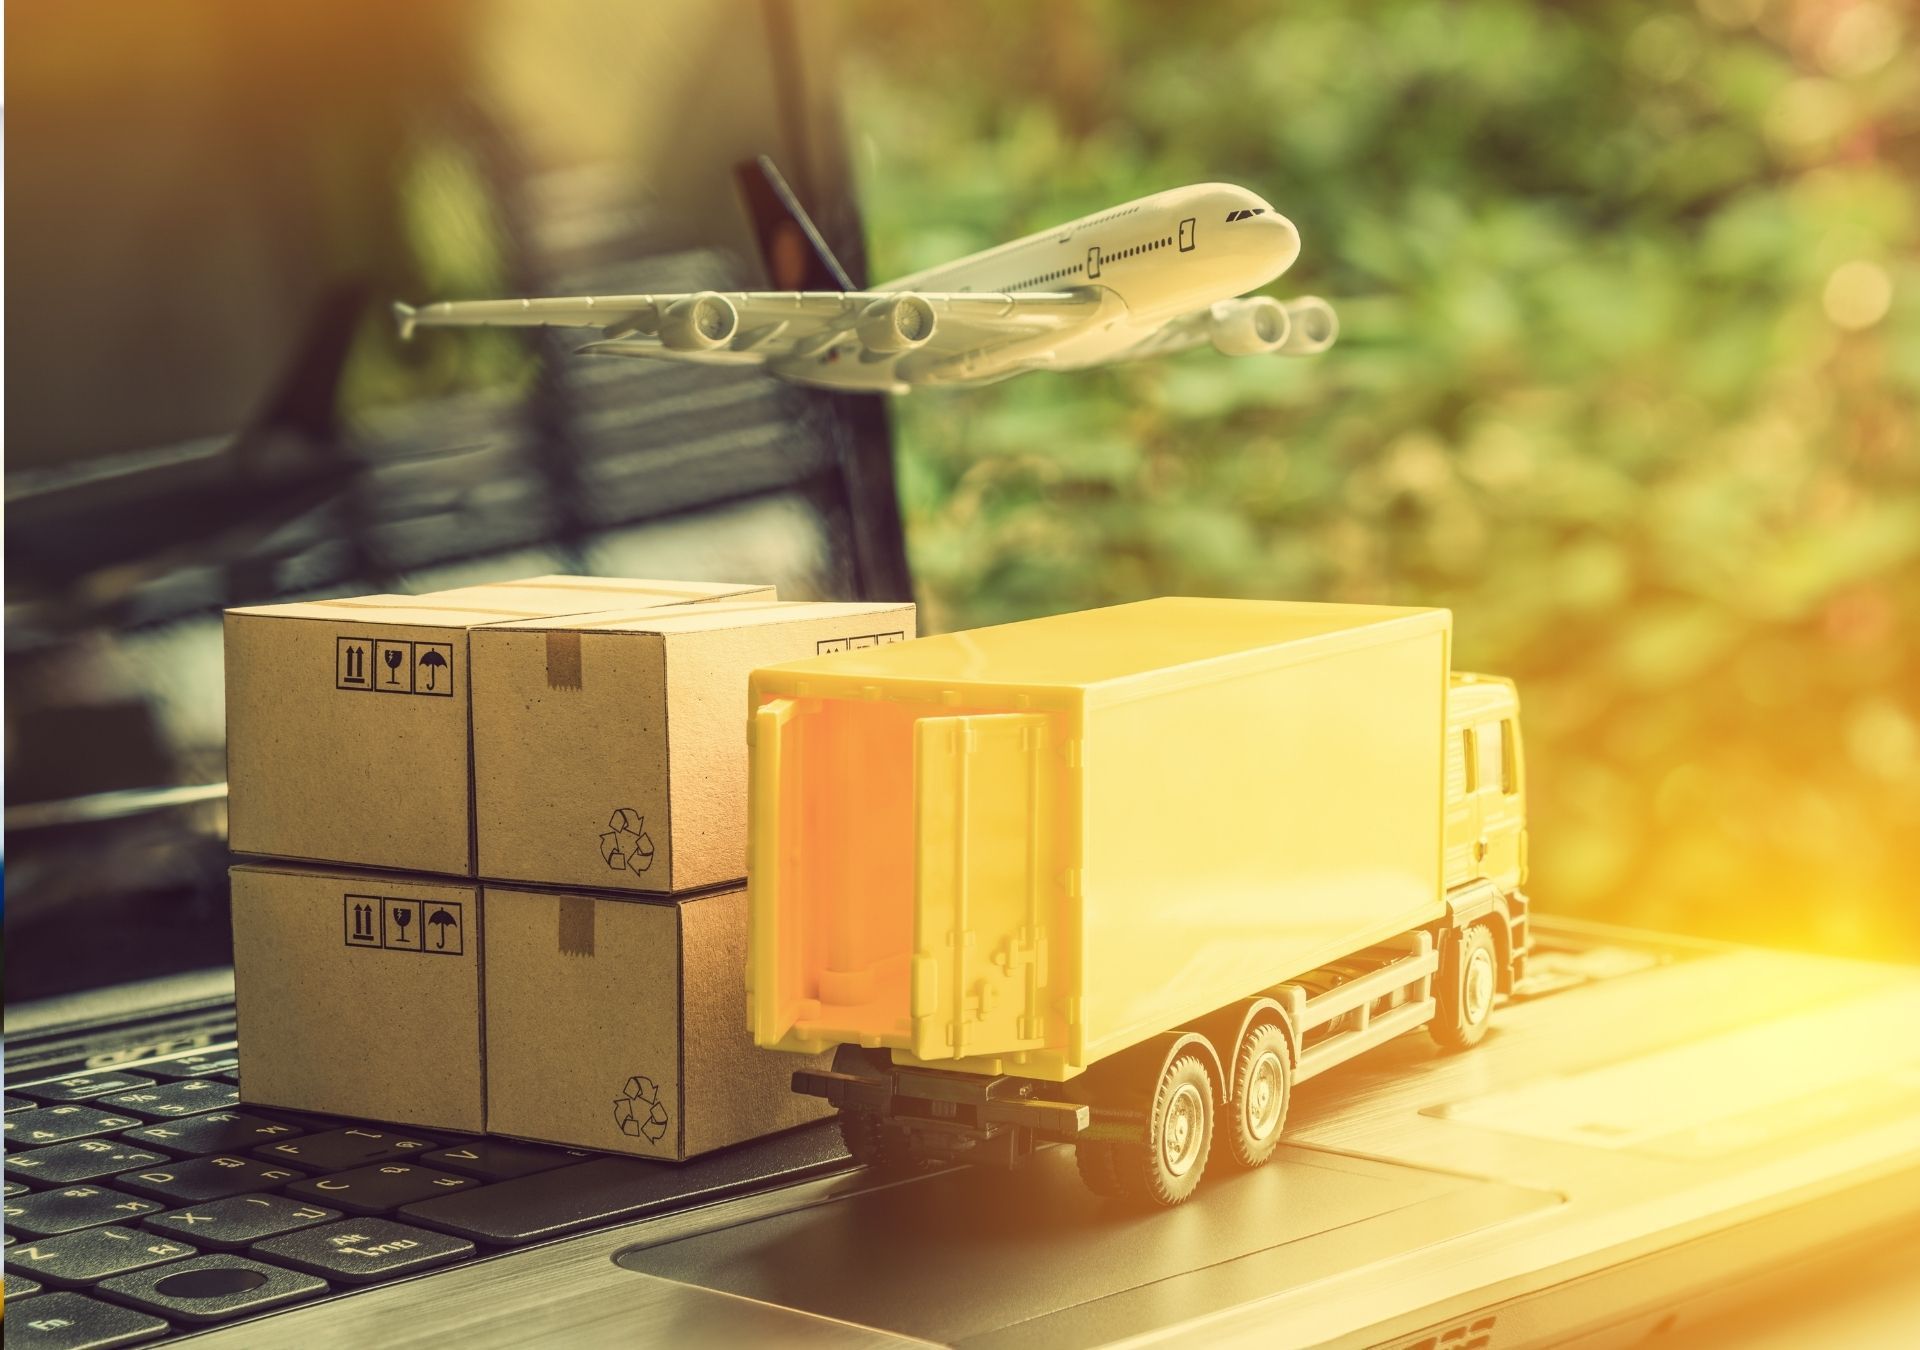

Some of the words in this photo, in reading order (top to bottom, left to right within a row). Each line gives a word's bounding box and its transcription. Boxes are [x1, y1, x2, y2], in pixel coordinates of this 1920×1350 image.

[119, 1094, 157, 1102] %
[159, 1104, 184, 1112] 5
[32, 1131, 54, 1139] 4
[144, 1128, 180, 1138] R
[275, 1144, 300, 1154] F
[444, 1150, 479, 1159] V
[5, 1157, 40, 1167] E
[139, 1173, 174, 1183] D
[316, 1180, 350, 1190] C
[169, 1212, 213, 1224] X
[332, 1233, 370, 1246] Alt
[338, 1239, 418, 1256] ไทย
[13, 1247, 58, 1260] Z
[27, 1319, 73, 1332] Fn
